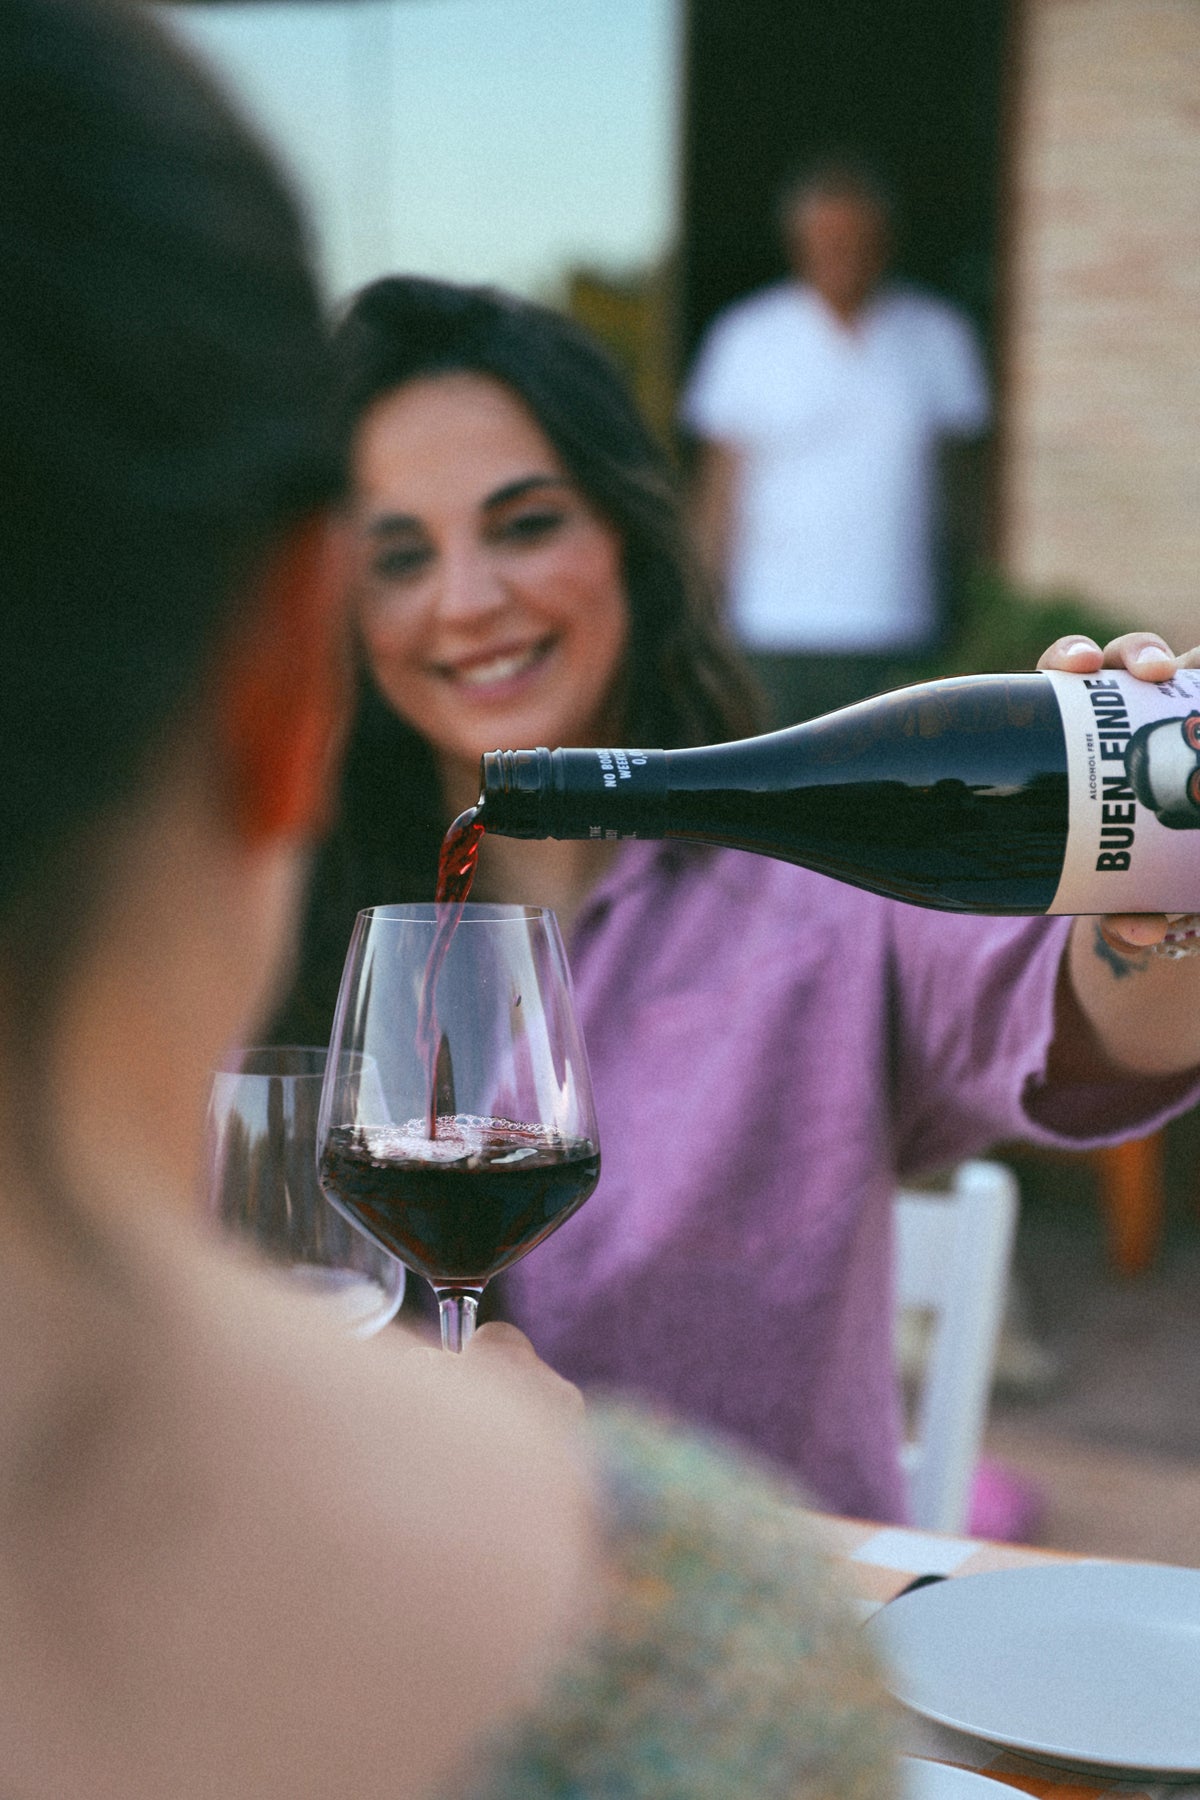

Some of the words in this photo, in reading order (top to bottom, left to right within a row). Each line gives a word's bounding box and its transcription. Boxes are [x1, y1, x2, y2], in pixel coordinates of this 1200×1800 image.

[1083, 679, 1133, 761] FINDE
[1086, 733, 1094, 752] FREE
[603, 773, 617, 787] NO
[1089, 755, 1098, 800] ALCOHOL
[1096, 776, 1137, 871] BUEN
